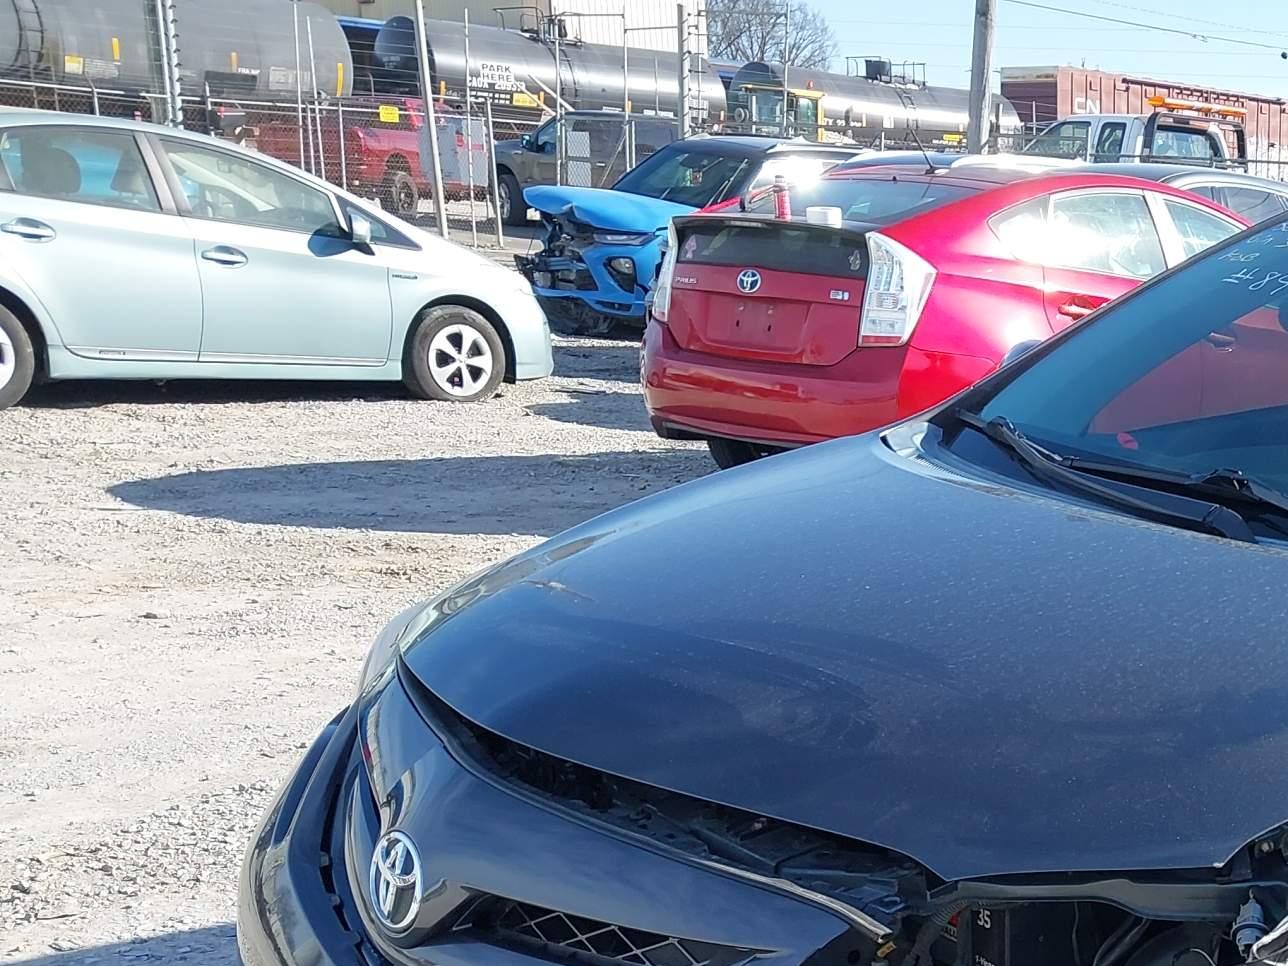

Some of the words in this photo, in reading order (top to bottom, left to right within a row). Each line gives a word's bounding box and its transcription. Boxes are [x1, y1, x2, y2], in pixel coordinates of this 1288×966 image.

[481, 63, 512, 74] PARK
[482, 72, 512, 83] HERE
[1074, 97, 1101, 114] CN
[977, 908, 991, 929] 35
